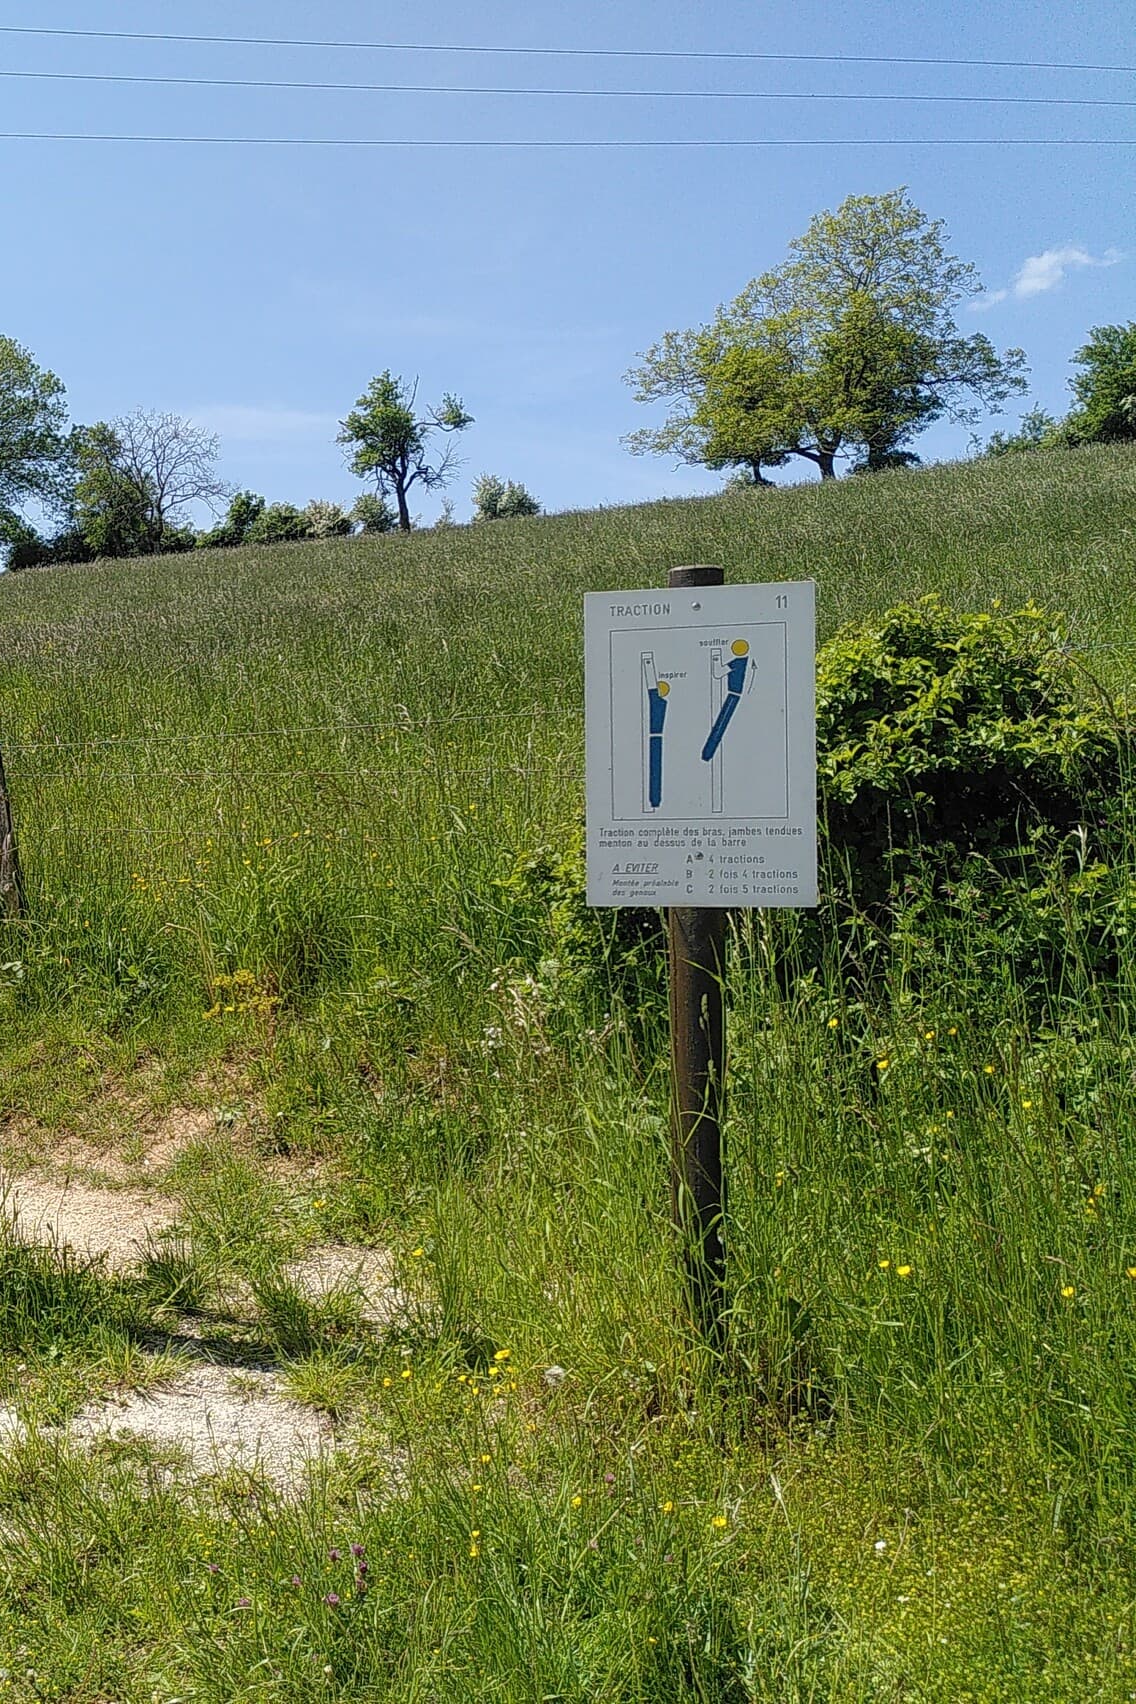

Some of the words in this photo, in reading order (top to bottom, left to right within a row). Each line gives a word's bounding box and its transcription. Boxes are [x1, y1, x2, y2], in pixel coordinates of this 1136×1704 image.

[775, 595, 788, 609] 11
[609, 603, 671, 617] TRACTION
[658, 671, 687, 680] inspirer
[599, 828, 635, 837] Traction
[638, 827, 679, 840] complète
[683, 827, 699, 836] des
[728, 827, 762, 837] jambes
[766, 826, 802, 836] tendues
[599, 840, 632, 848] menton
[637, 840, 649, 848] au
[654, 838, 686, 847] dessus
[691, 838, 702, 847] de
[707, 838, 717, 847] la
[722, 838, 746, 847] barre
[686, 854, 693, 864] A
[709, 855, 714, 864] 4
[719, 855, 765, 864] tractions
[612, 863, 620, 872] A
[625, 863, 659, 873] EVITER
[686, 870, 693, 879] B
[708, 869, 714, 879] 2
[720, 870, 738, 879] fois
[742, 870, 748, 879] 4
[752, 869, 798, 879] tractions
[686, 884, 693, 894] C
[708, 884, 714, 894] 2
[720, 885, 738, 894] fois
[742, 885, 749, 894] 5
[752, 884, 799, 894] tractions
